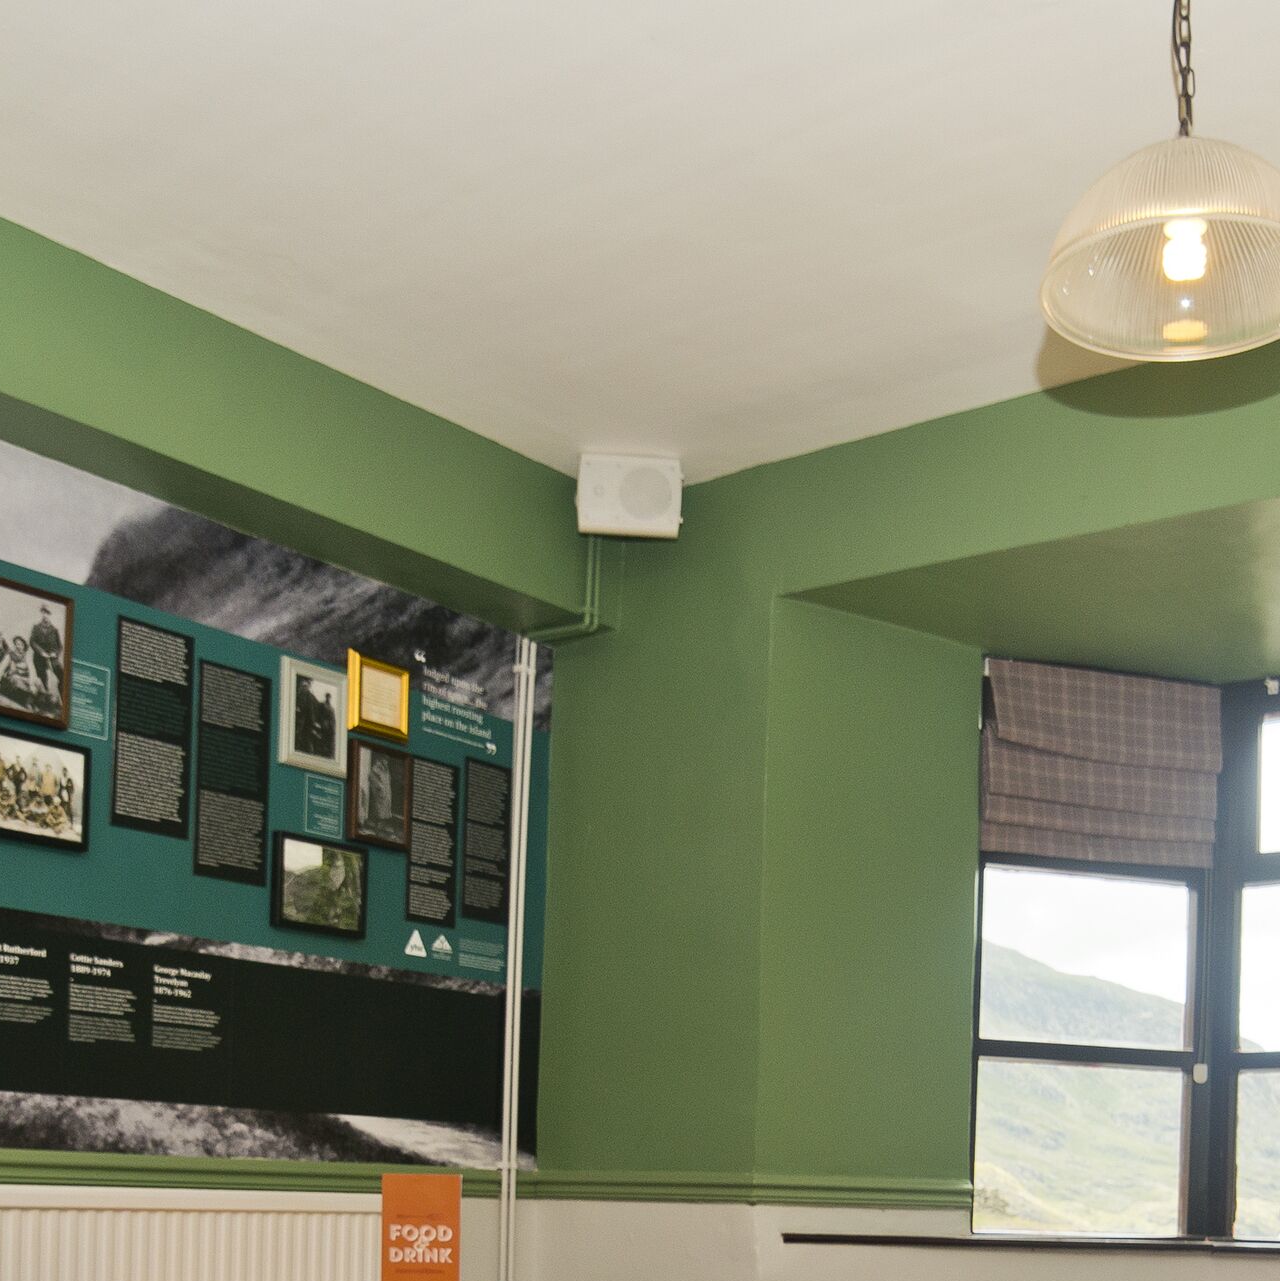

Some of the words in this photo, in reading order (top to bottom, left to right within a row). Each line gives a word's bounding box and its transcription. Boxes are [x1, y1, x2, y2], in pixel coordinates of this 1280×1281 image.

[389, 1223, 453, 1242] FOOD
[413, 1236, 430, 1251] &
[388, 1247, 453, 1264] DRINK
